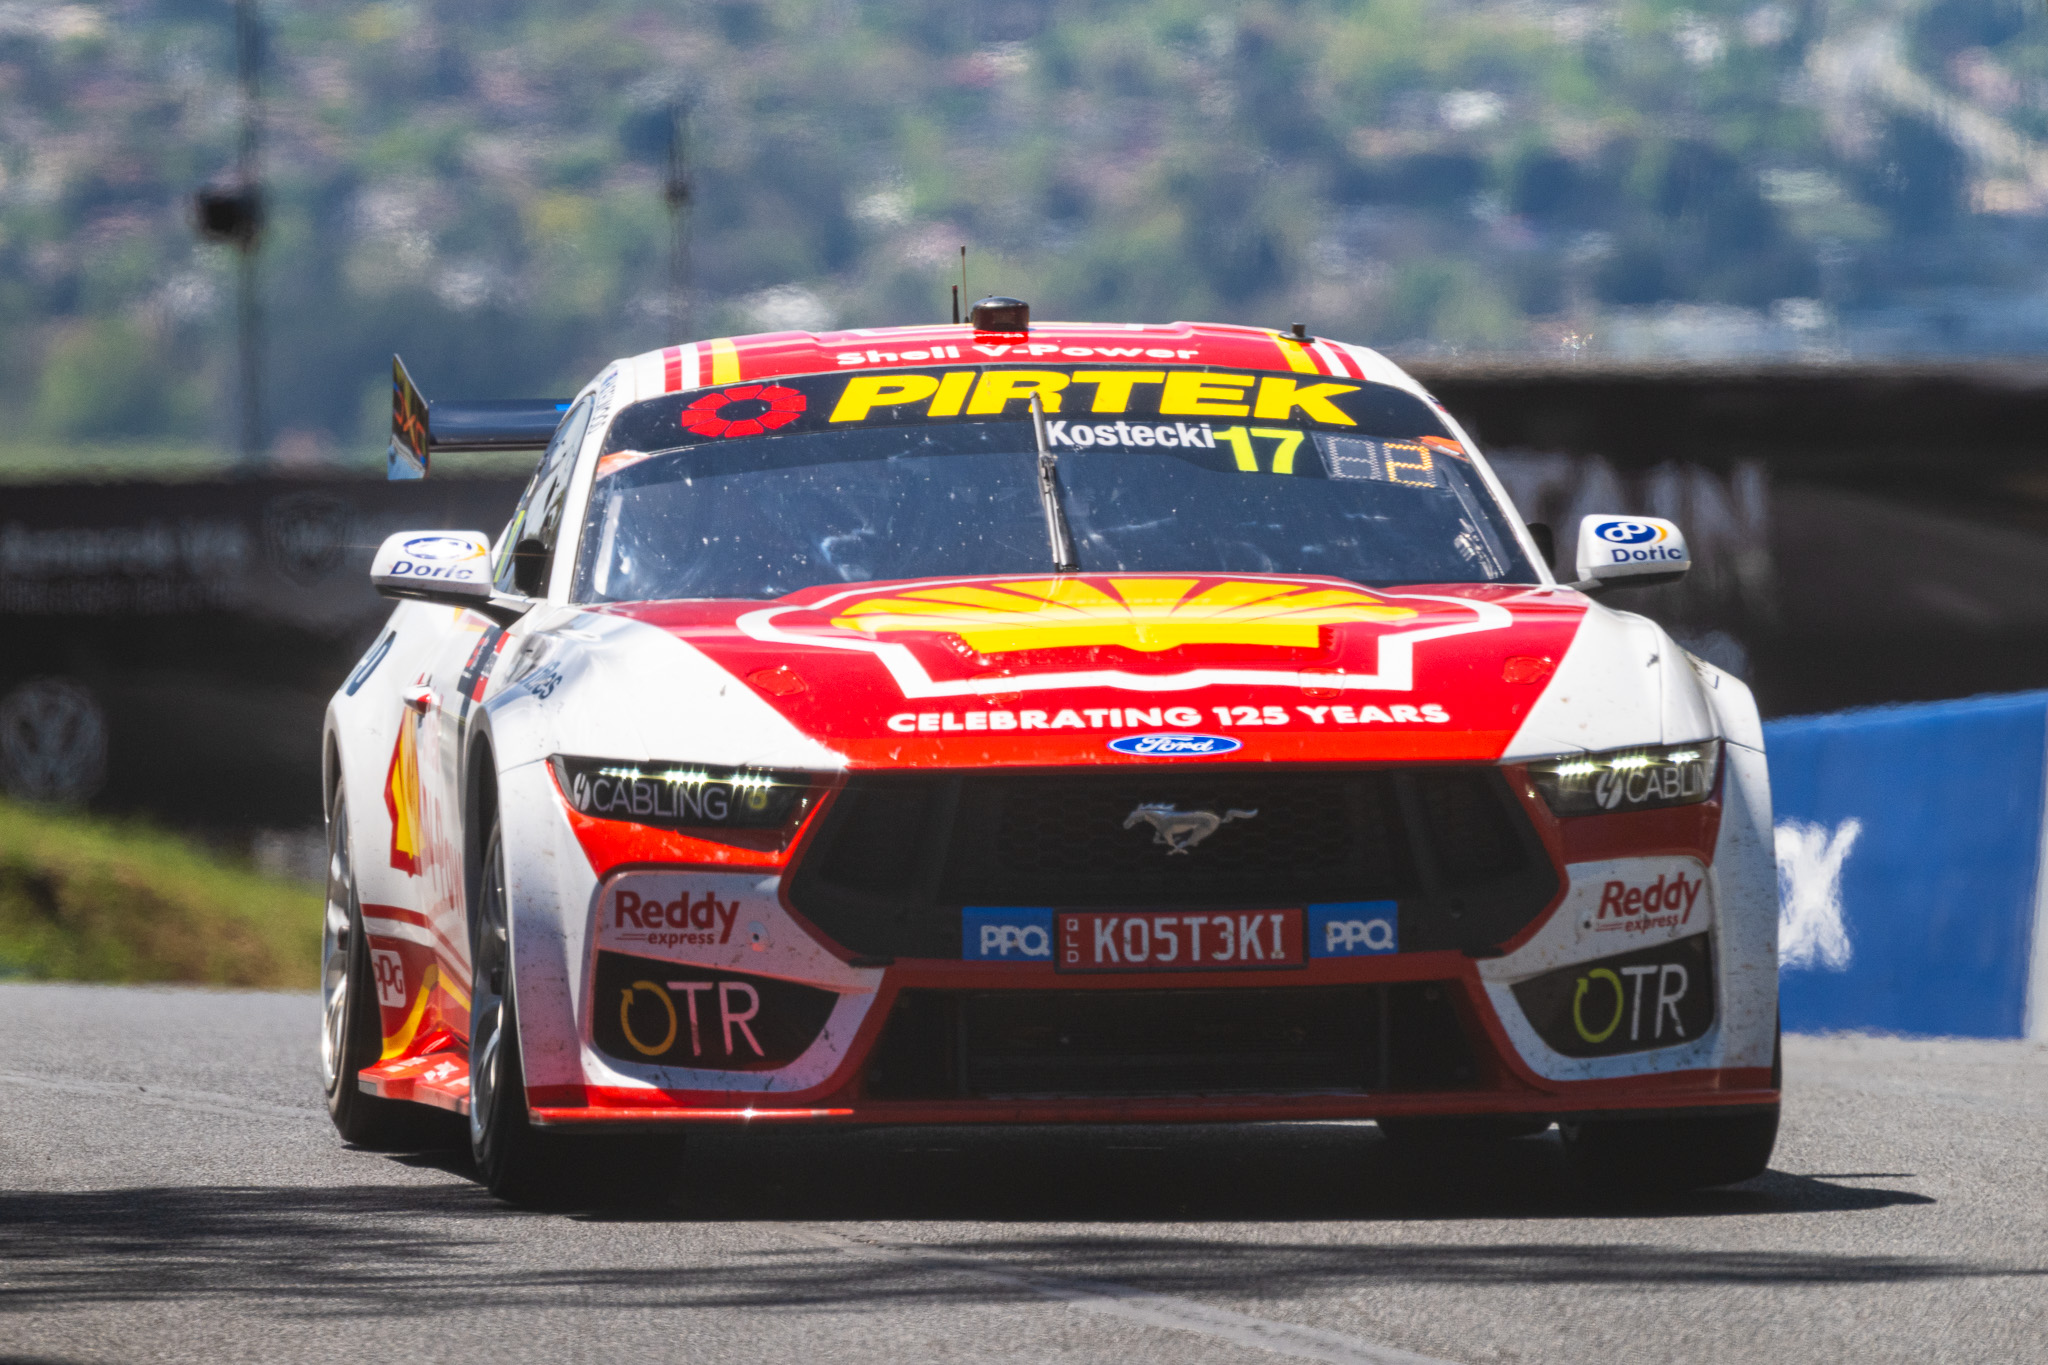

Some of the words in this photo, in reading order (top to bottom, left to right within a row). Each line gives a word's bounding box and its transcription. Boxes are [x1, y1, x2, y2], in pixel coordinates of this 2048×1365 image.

[836, 345, 960, 365] Shell
[972, 344, 1199, 360] V-Power
[829, 370, 1359, 426] PIRTEK
[1047, 419, 1217, 449] Kostecki
[1213, 426, 1304, 475] 17
[390, 560, 473, 580] Doric
[1611, 545, 1682, 563] Doric
[887, 705, 1202, 733] CELEBRATING
[1212, 706, 1291, 726] 125
[1297, 703, 1451, 725] YEARS
[1134, 736, 1215, 756] Ford
[1597, 871, 1702, 925] Reddy
[614, 890, 740, 945] Reddy
[1624, 913, 1679, 937] express
[646, 931, 715, 949] express
[980, 925, 1050, 957] PPQ
[1326, 919, 1394, 952] PPQ
[620, 980, 765, 1056] OTR
[1573, 963, 1688, 1043] OTR
